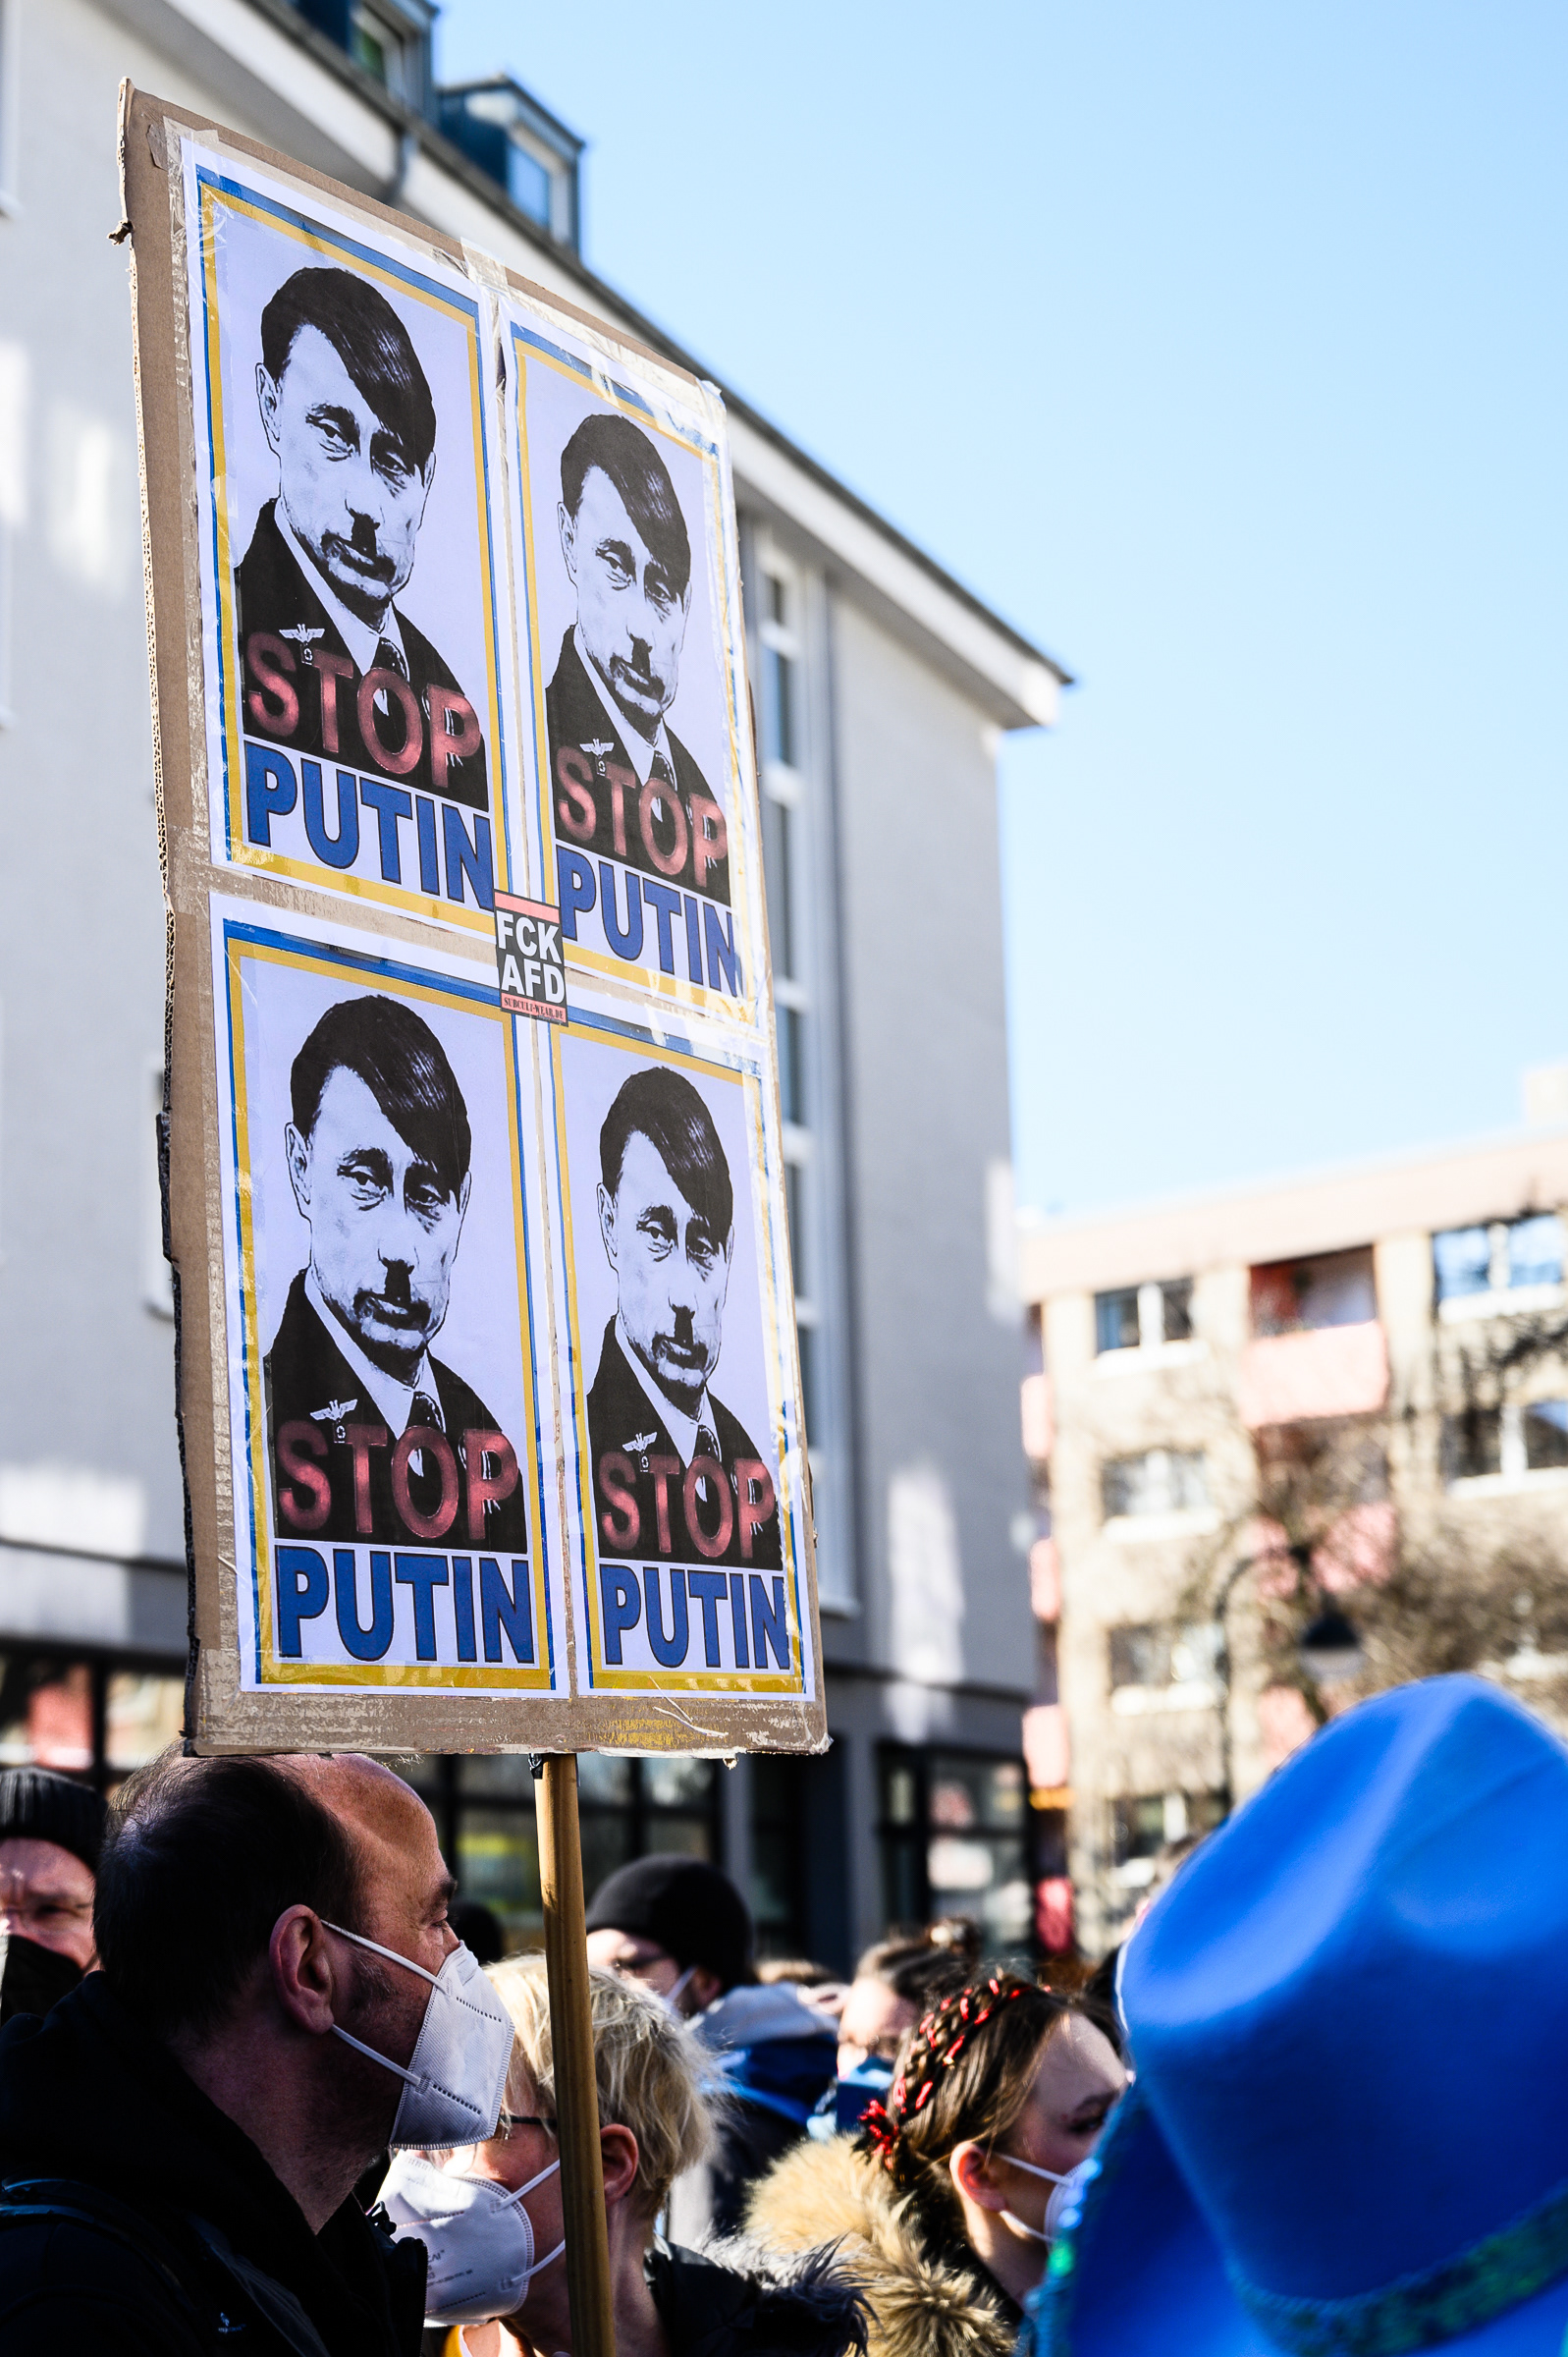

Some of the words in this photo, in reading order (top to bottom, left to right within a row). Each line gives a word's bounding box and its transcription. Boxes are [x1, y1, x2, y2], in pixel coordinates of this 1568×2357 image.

[247, 631, 480, 788] STOP
[243, 740, 494, 912] PUTIN
[557, 745, 728, 887] STOP
[496, 909, 563, 964] FCK
[501, 954, 565, 1004] AFD
[556, 844, 744, 999] PUTIN
[277, 1420, 518, 1540] STOP
[598, 1451, 776, 1560] STOP
[275, 1545, 535, 1664] PUTIN
[599, 1563, 789, 1670] PUTIN
